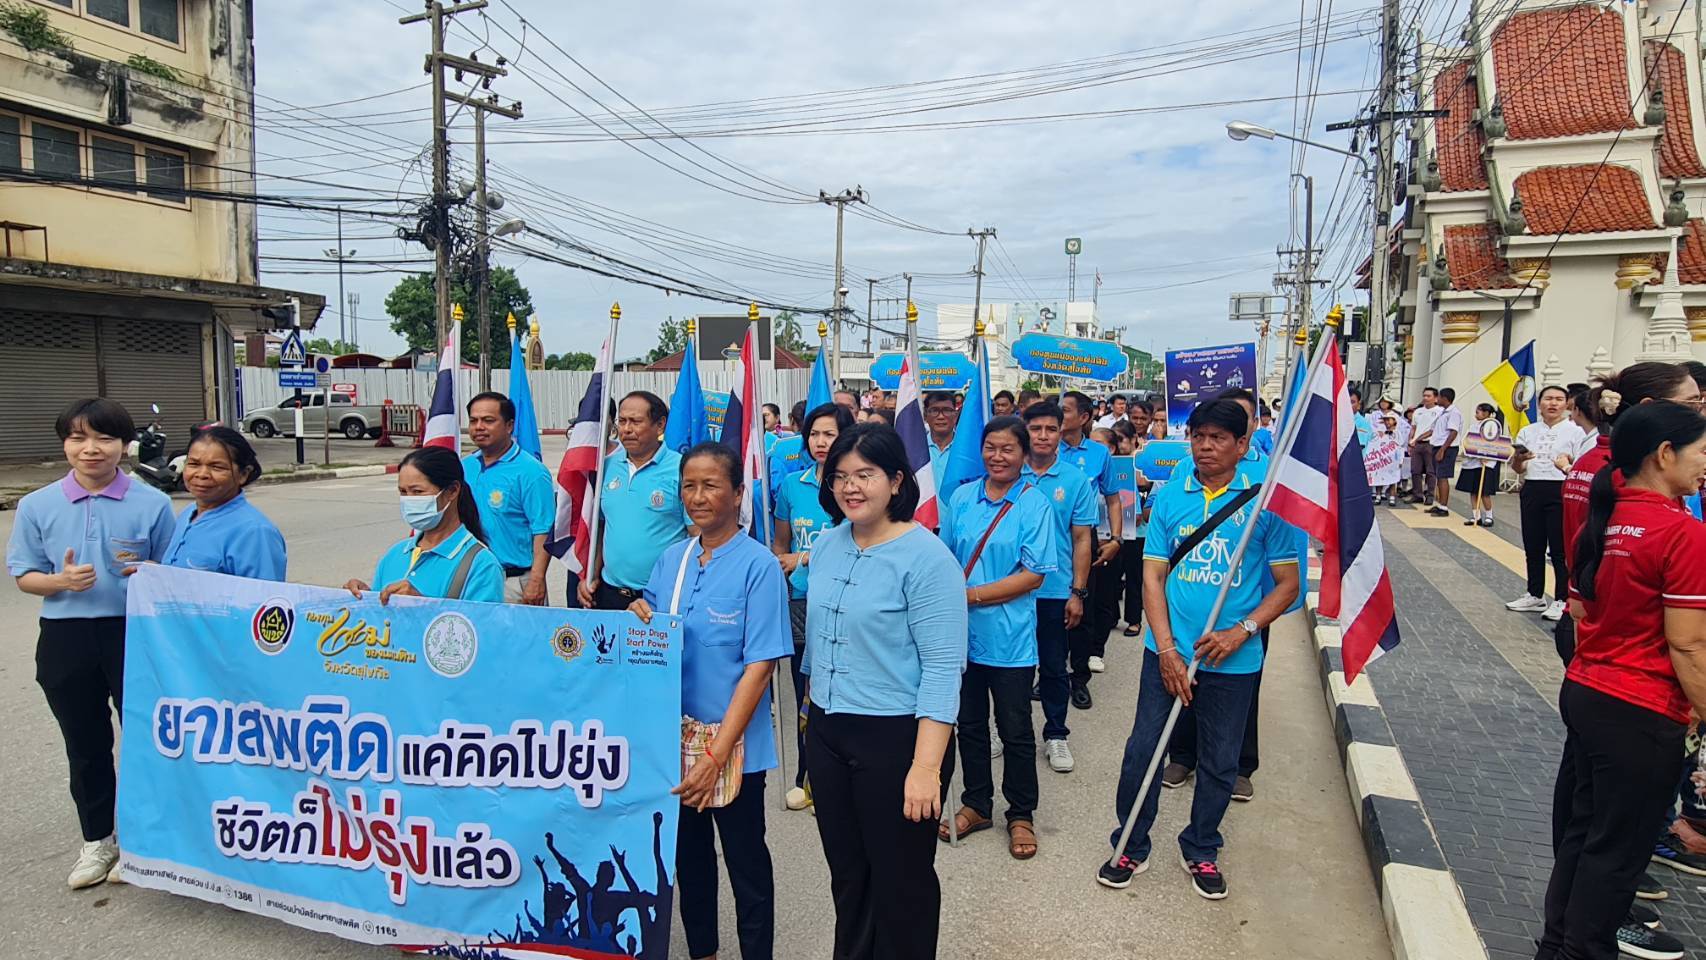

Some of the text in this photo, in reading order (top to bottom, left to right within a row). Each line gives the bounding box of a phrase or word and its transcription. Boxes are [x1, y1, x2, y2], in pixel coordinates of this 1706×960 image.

[1621, 525, 1646, 538] ONE
[628, 627, 668, 640] Stop Drugs
[626, 638, 670, 649] Start Power
[156, 703, 623, 797] ยาเสพติด แค่คิดไปยุ่ง
[233, 890, 253, 902] 1386
[375, 925, 398, 937] 1165
